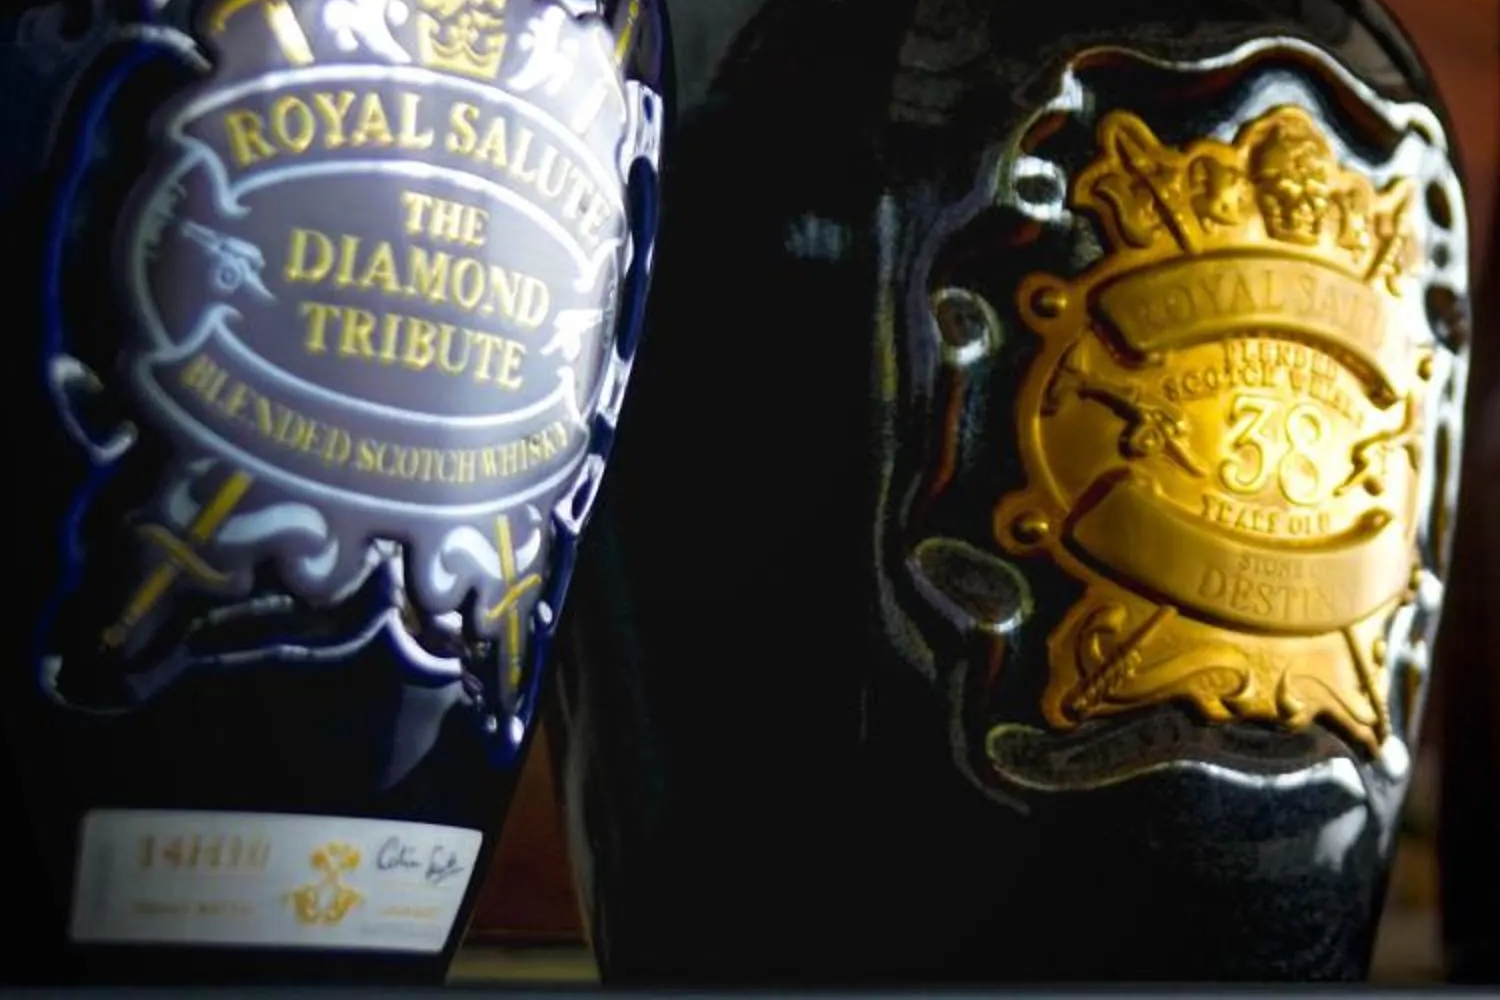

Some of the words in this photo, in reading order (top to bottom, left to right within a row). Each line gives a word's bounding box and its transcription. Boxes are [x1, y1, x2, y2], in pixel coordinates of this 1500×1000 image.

[224, 91, 434, 168] ROYAL
[447, 102, 608, 238] SALUTE
[402, 191, 490, 246] THE
[285, 229, 550, 328] DIAMOND
[302, 302, 528, 389] TRIBUTE
[180, 355, 351, 462] BLENDED
[357, 441, 476, 483] SCOTCH
[480, 418, 570, 479] WHISKY
[1216, 392, 1332, 506] 38
